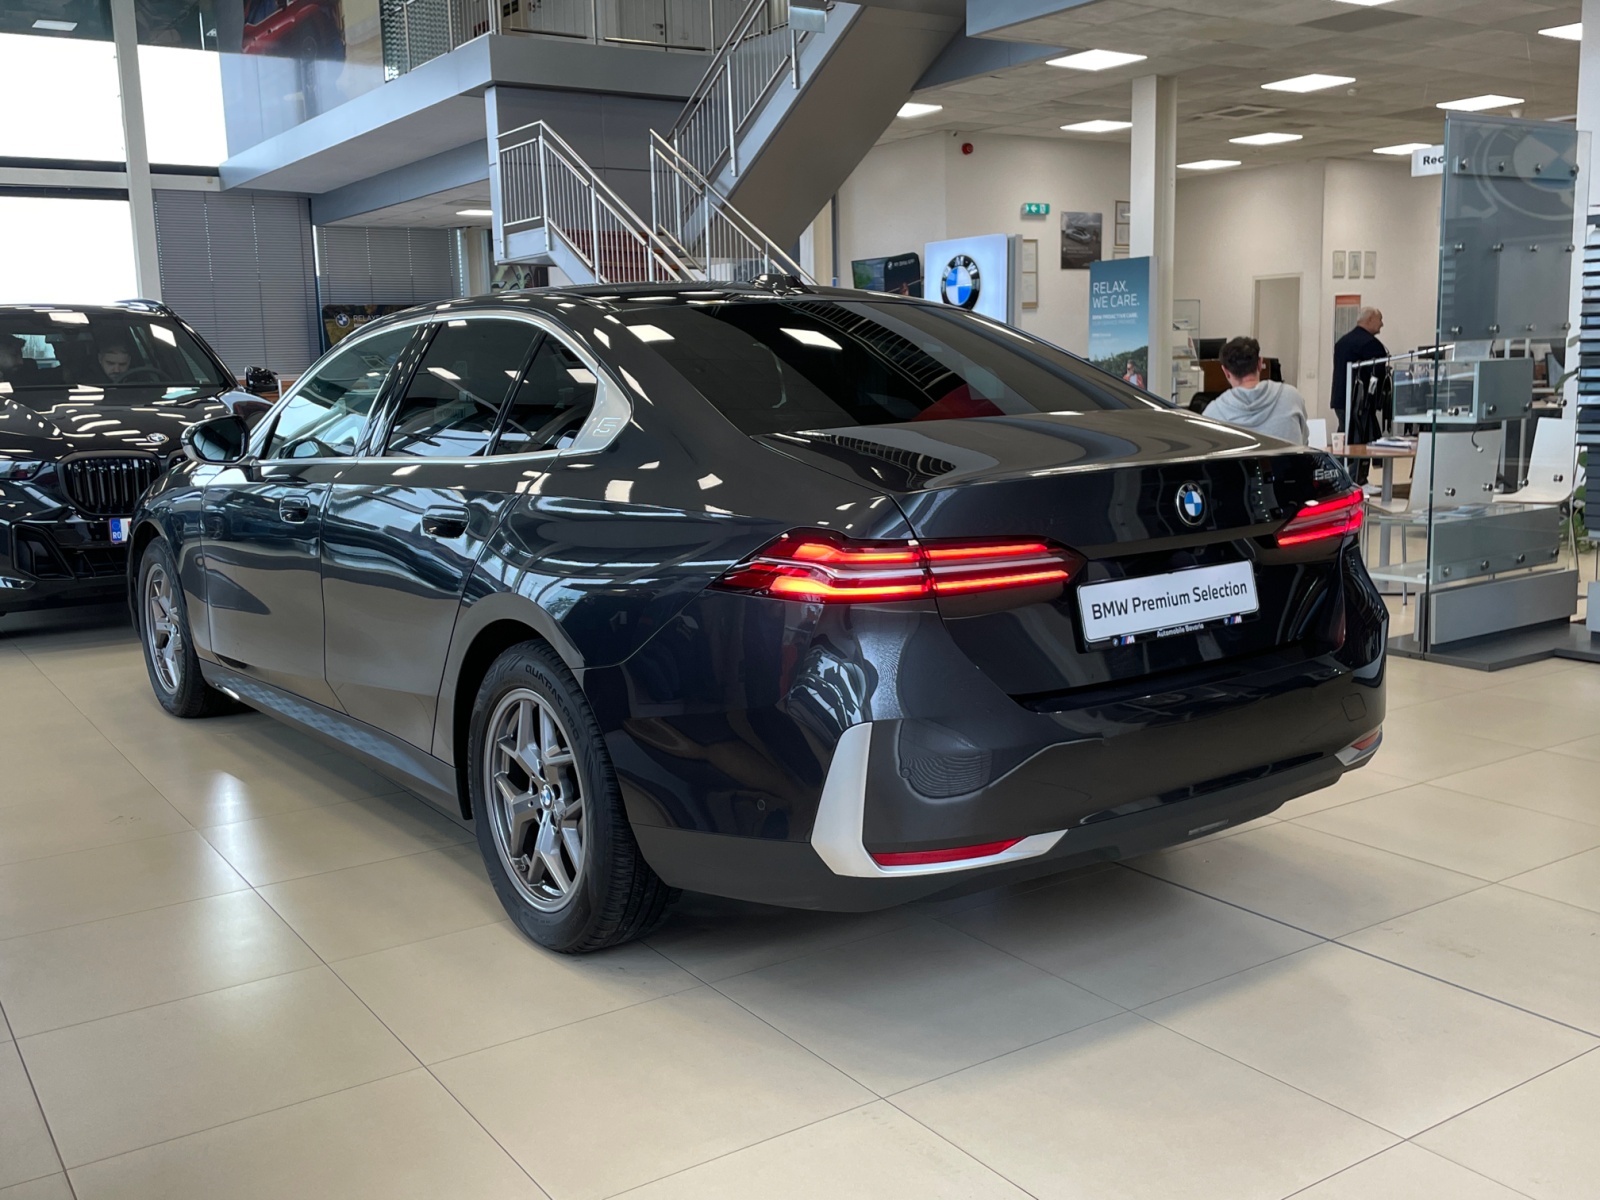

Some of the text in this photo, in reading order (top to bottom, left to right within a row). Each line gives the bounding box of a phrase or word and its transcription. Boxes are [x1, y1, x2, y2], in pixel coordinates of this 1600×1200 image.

[1092, 280, 1129, 294] RELAX.
[1092, 293, 1140, 308] WE CARE.
[113, 531, 121, 539] RO
[1091, 581, 1247, 620] BMW Premium Selection
[525, 664, 580, 740] QUATRAC PRO
